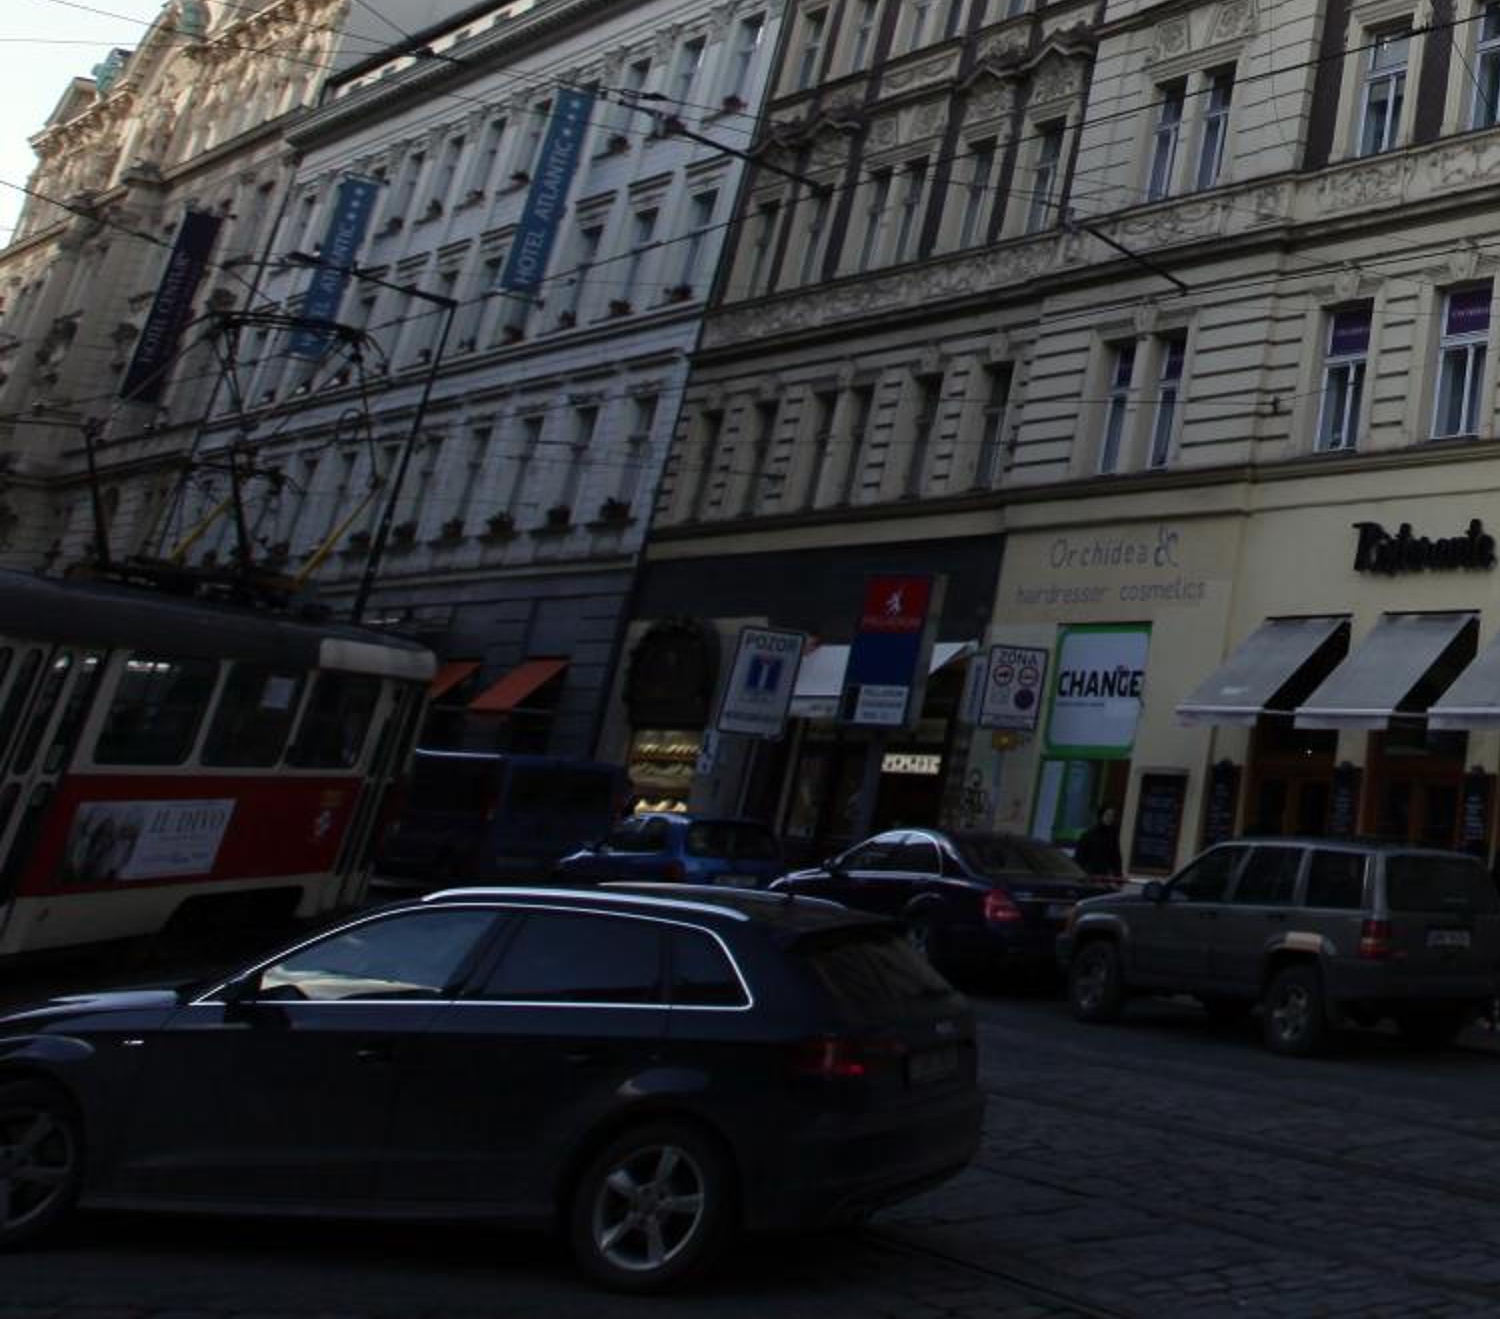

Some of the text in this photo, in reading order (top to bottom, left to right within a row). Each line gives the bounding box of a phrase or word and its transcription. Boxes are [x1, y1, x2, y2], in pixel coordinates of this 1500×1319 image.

[513, 136, 574, 285] HOTEL ATLANTIC
[1050, 537, 1148, 569] Orchidea
[1119, 578, 1206, 602] cosmetics
[1056, 669, 1144, 698] CHANGE
